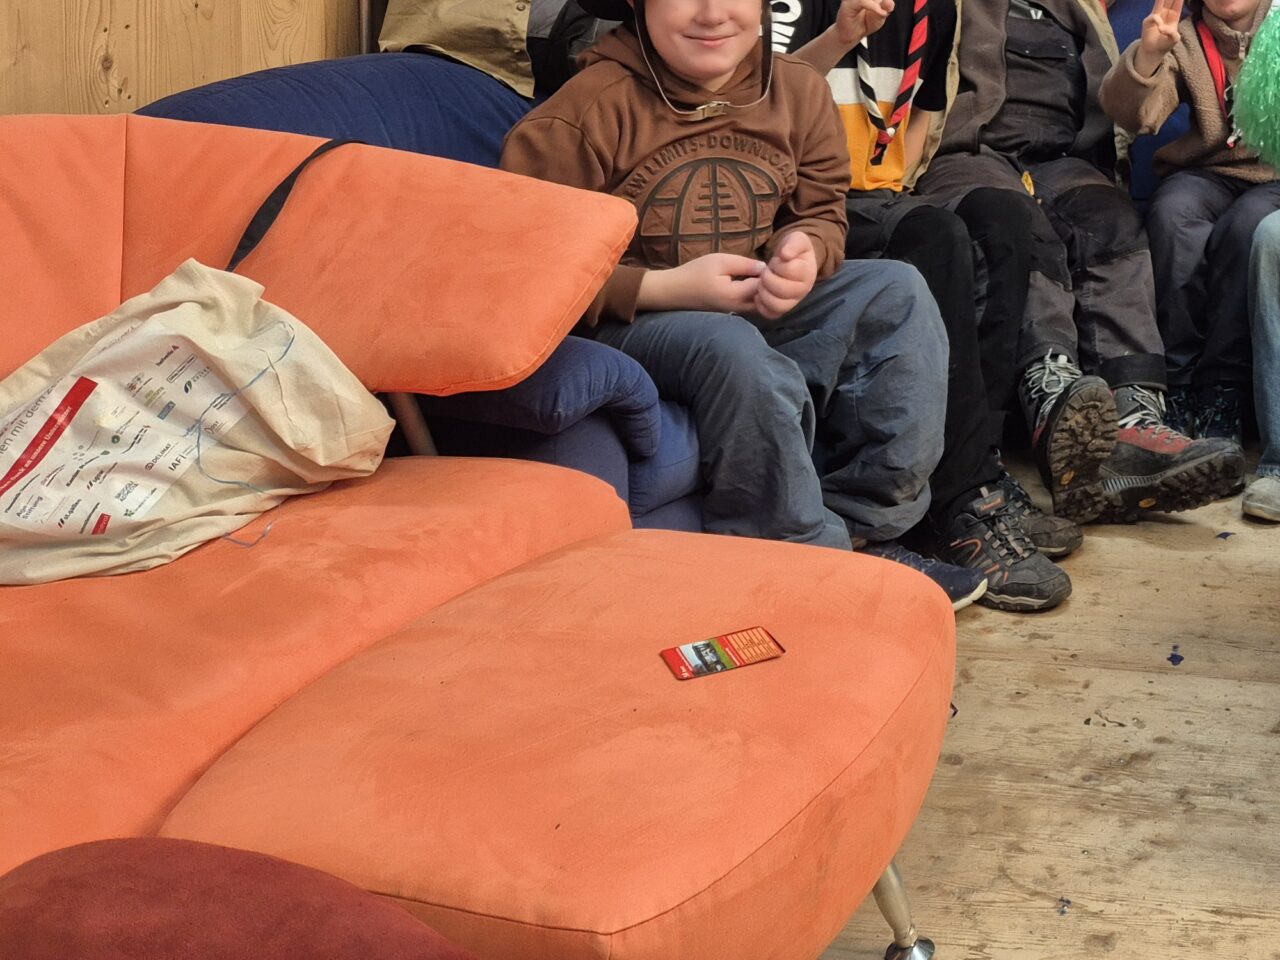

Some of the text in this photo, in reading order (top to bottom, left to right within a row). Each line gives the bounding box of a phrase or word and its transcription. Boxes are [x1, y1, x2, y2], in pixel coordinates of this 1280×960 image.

[11, 417, 28, 437] mit
[25, 394, 47, 419] dem
[152, 443, 172, 464] DELINAT
